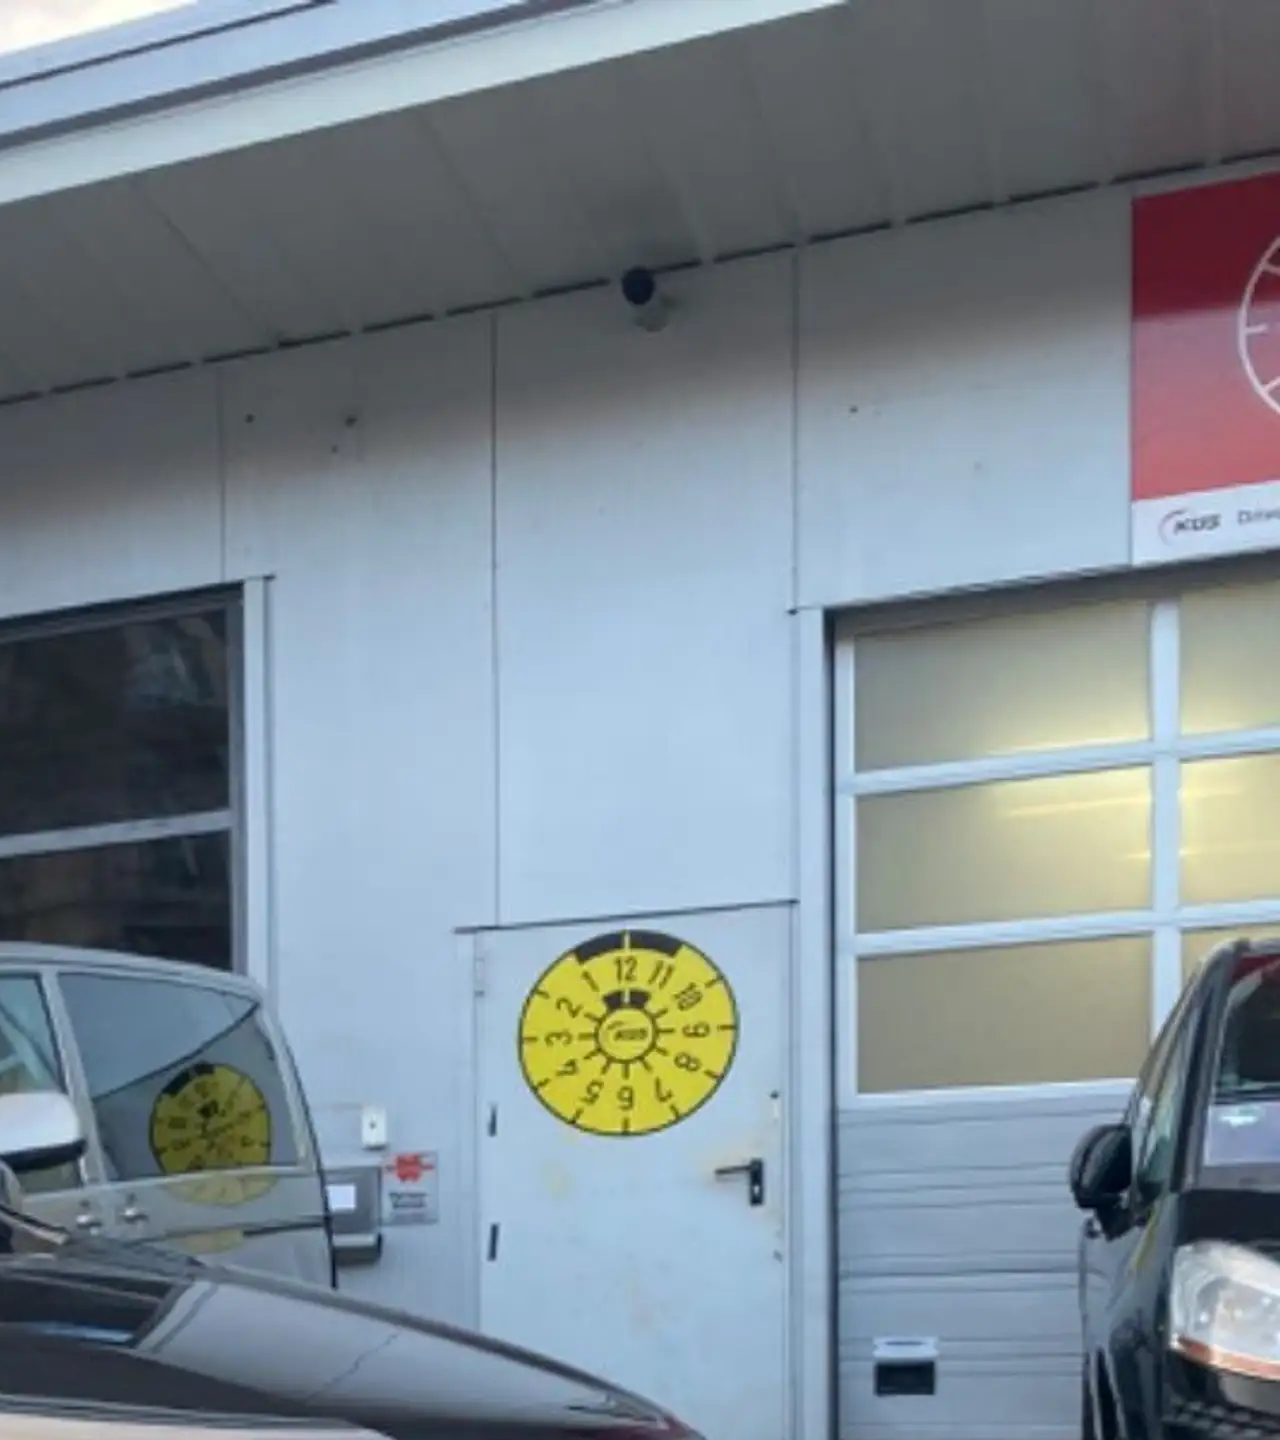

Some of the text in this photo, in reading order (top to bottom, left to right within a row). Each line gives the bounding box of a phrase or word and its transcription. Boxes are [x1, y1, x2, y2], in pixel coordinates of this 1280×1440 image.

[613, 956, 637, 982] 12
[648, 960, 675, 990] 11
[581, 970, 600, 992] 1
[555, 996, 583, 1019] 2
[543, 1030, 573, 1047] 3
[673, 1051, 702, 1073] 8
